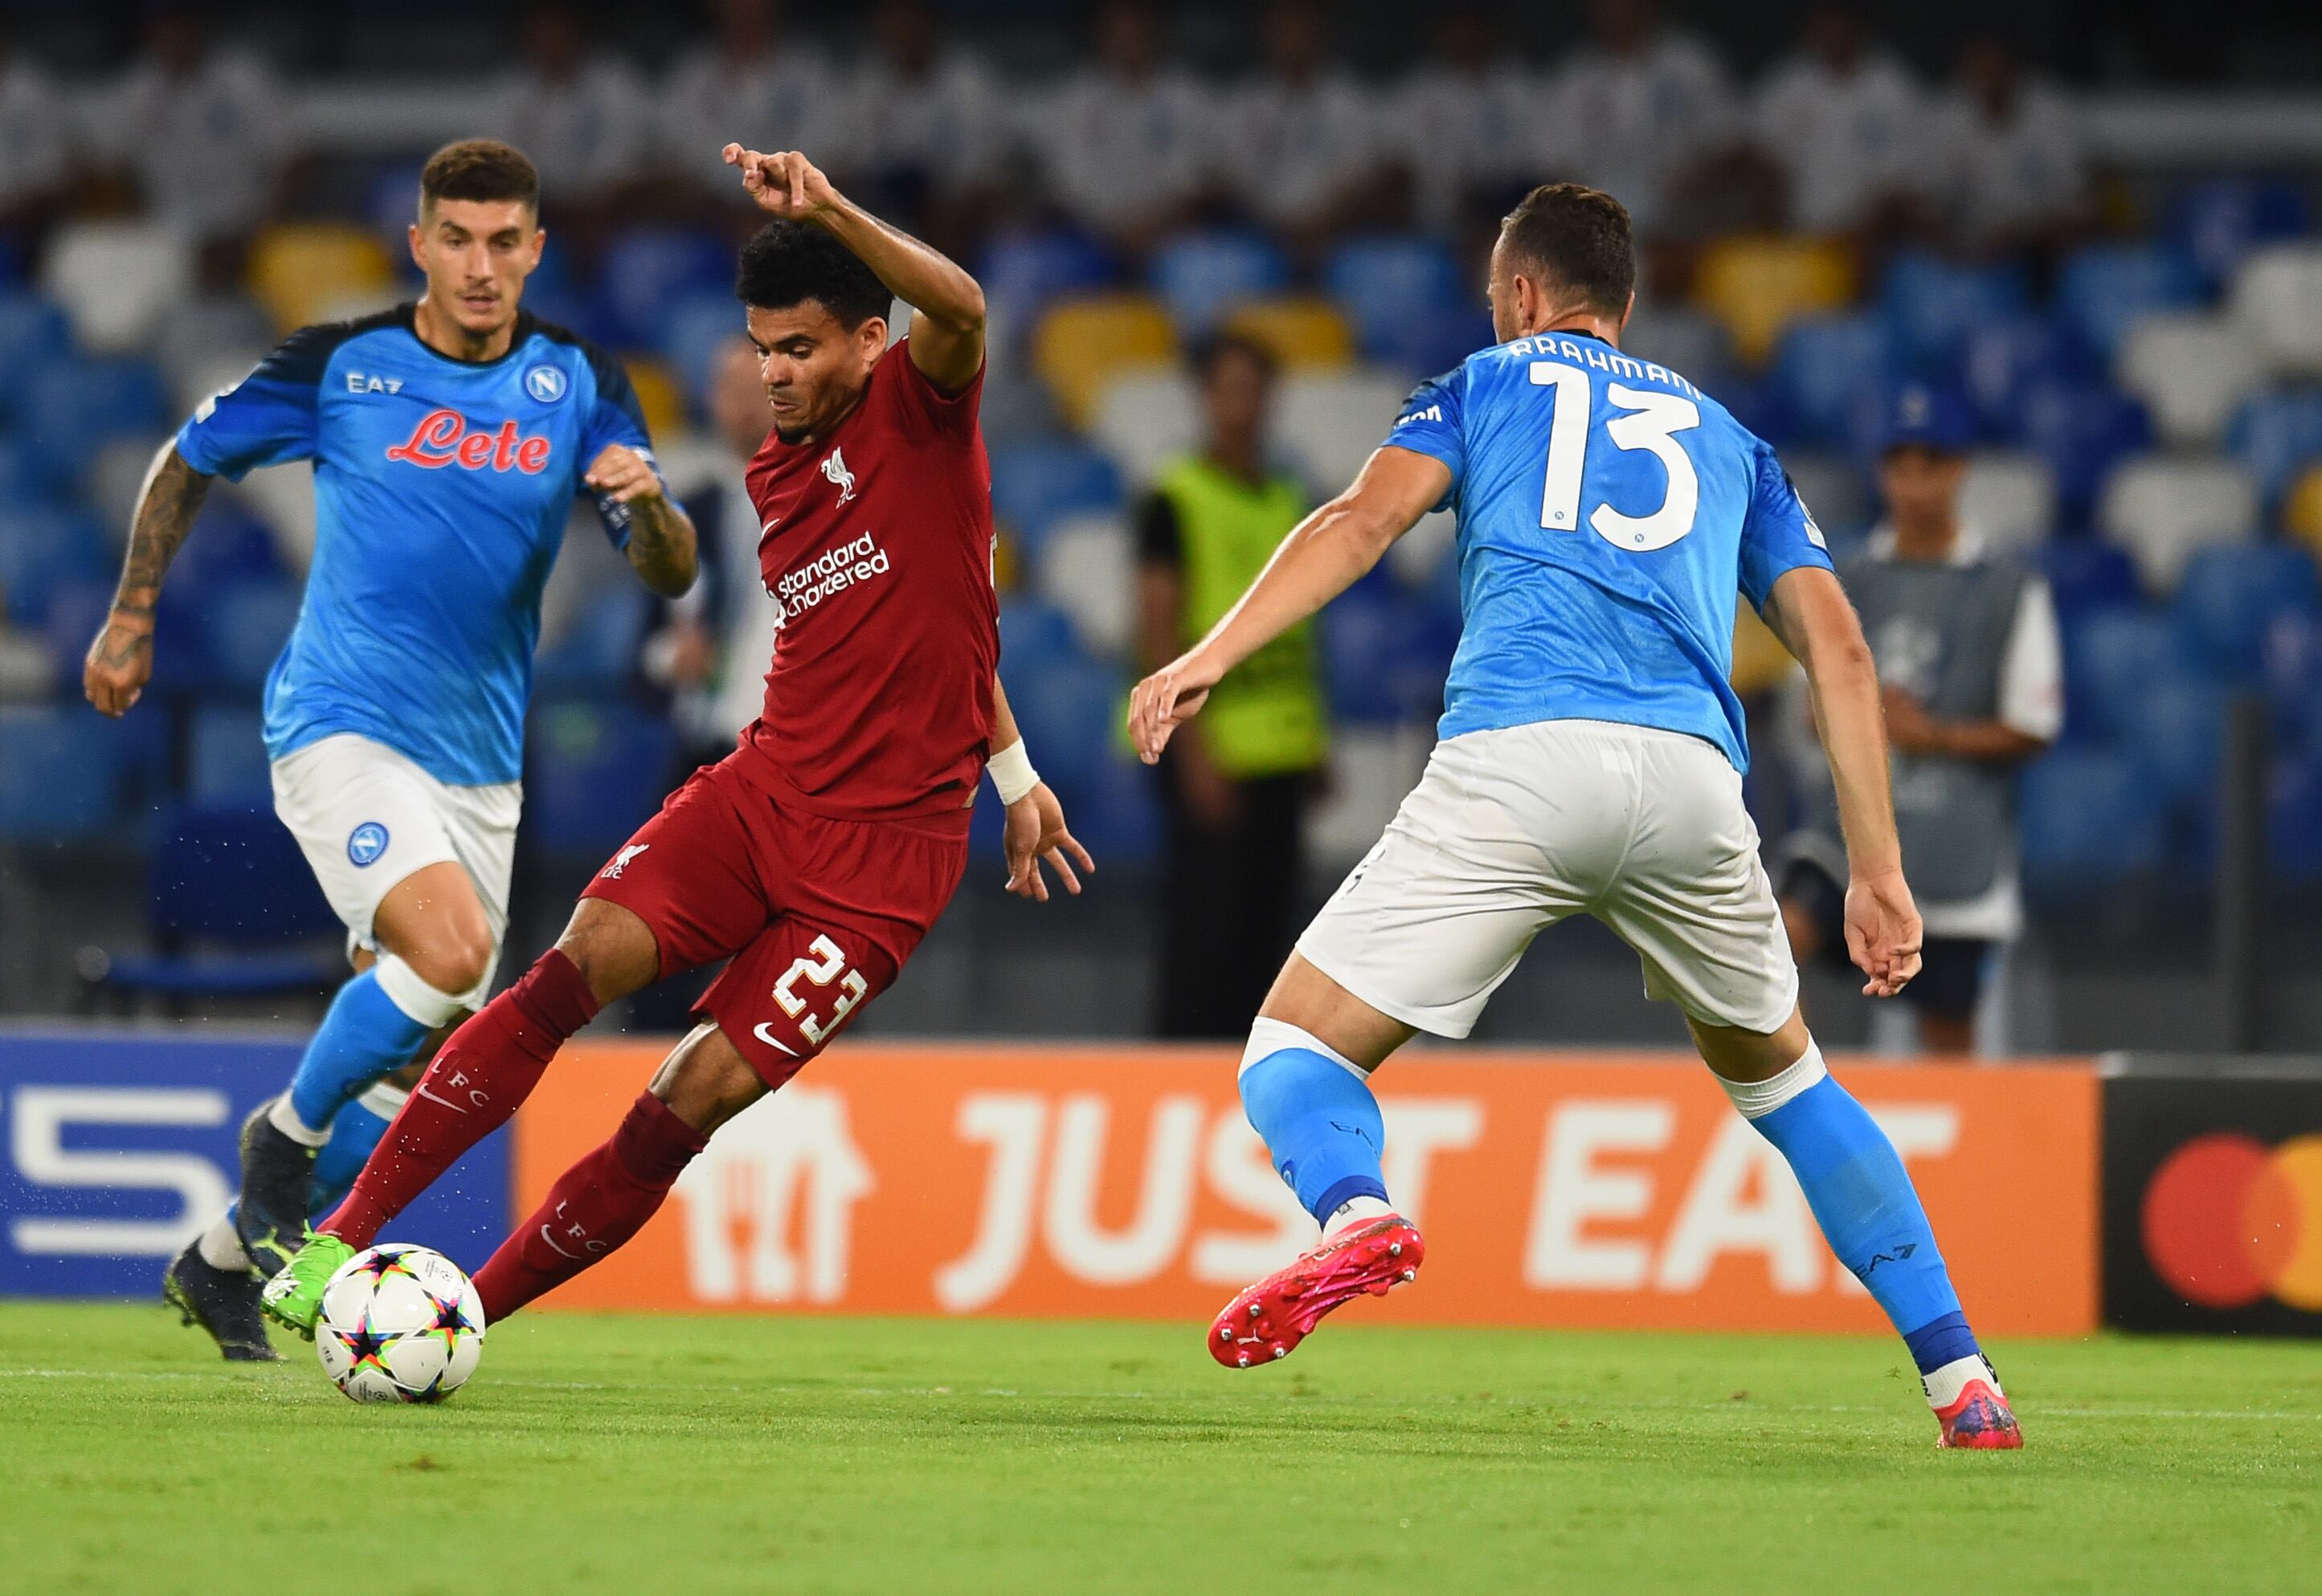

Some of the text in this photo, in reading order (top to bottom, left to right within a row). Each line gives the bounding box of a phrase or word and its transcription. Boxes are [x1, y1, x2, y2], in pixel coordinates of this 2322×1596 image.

[346, 372, 403, 394] EA7
[386, 408, 551, 476] Lete
[1529, 361, 1700, 553] 13
[778, 530, 875, 599] standard
[787, 549, 890, 617] chartered
[772, 933, 869, 1047] 23
[934, 1091, 1485, 1313] JUST
